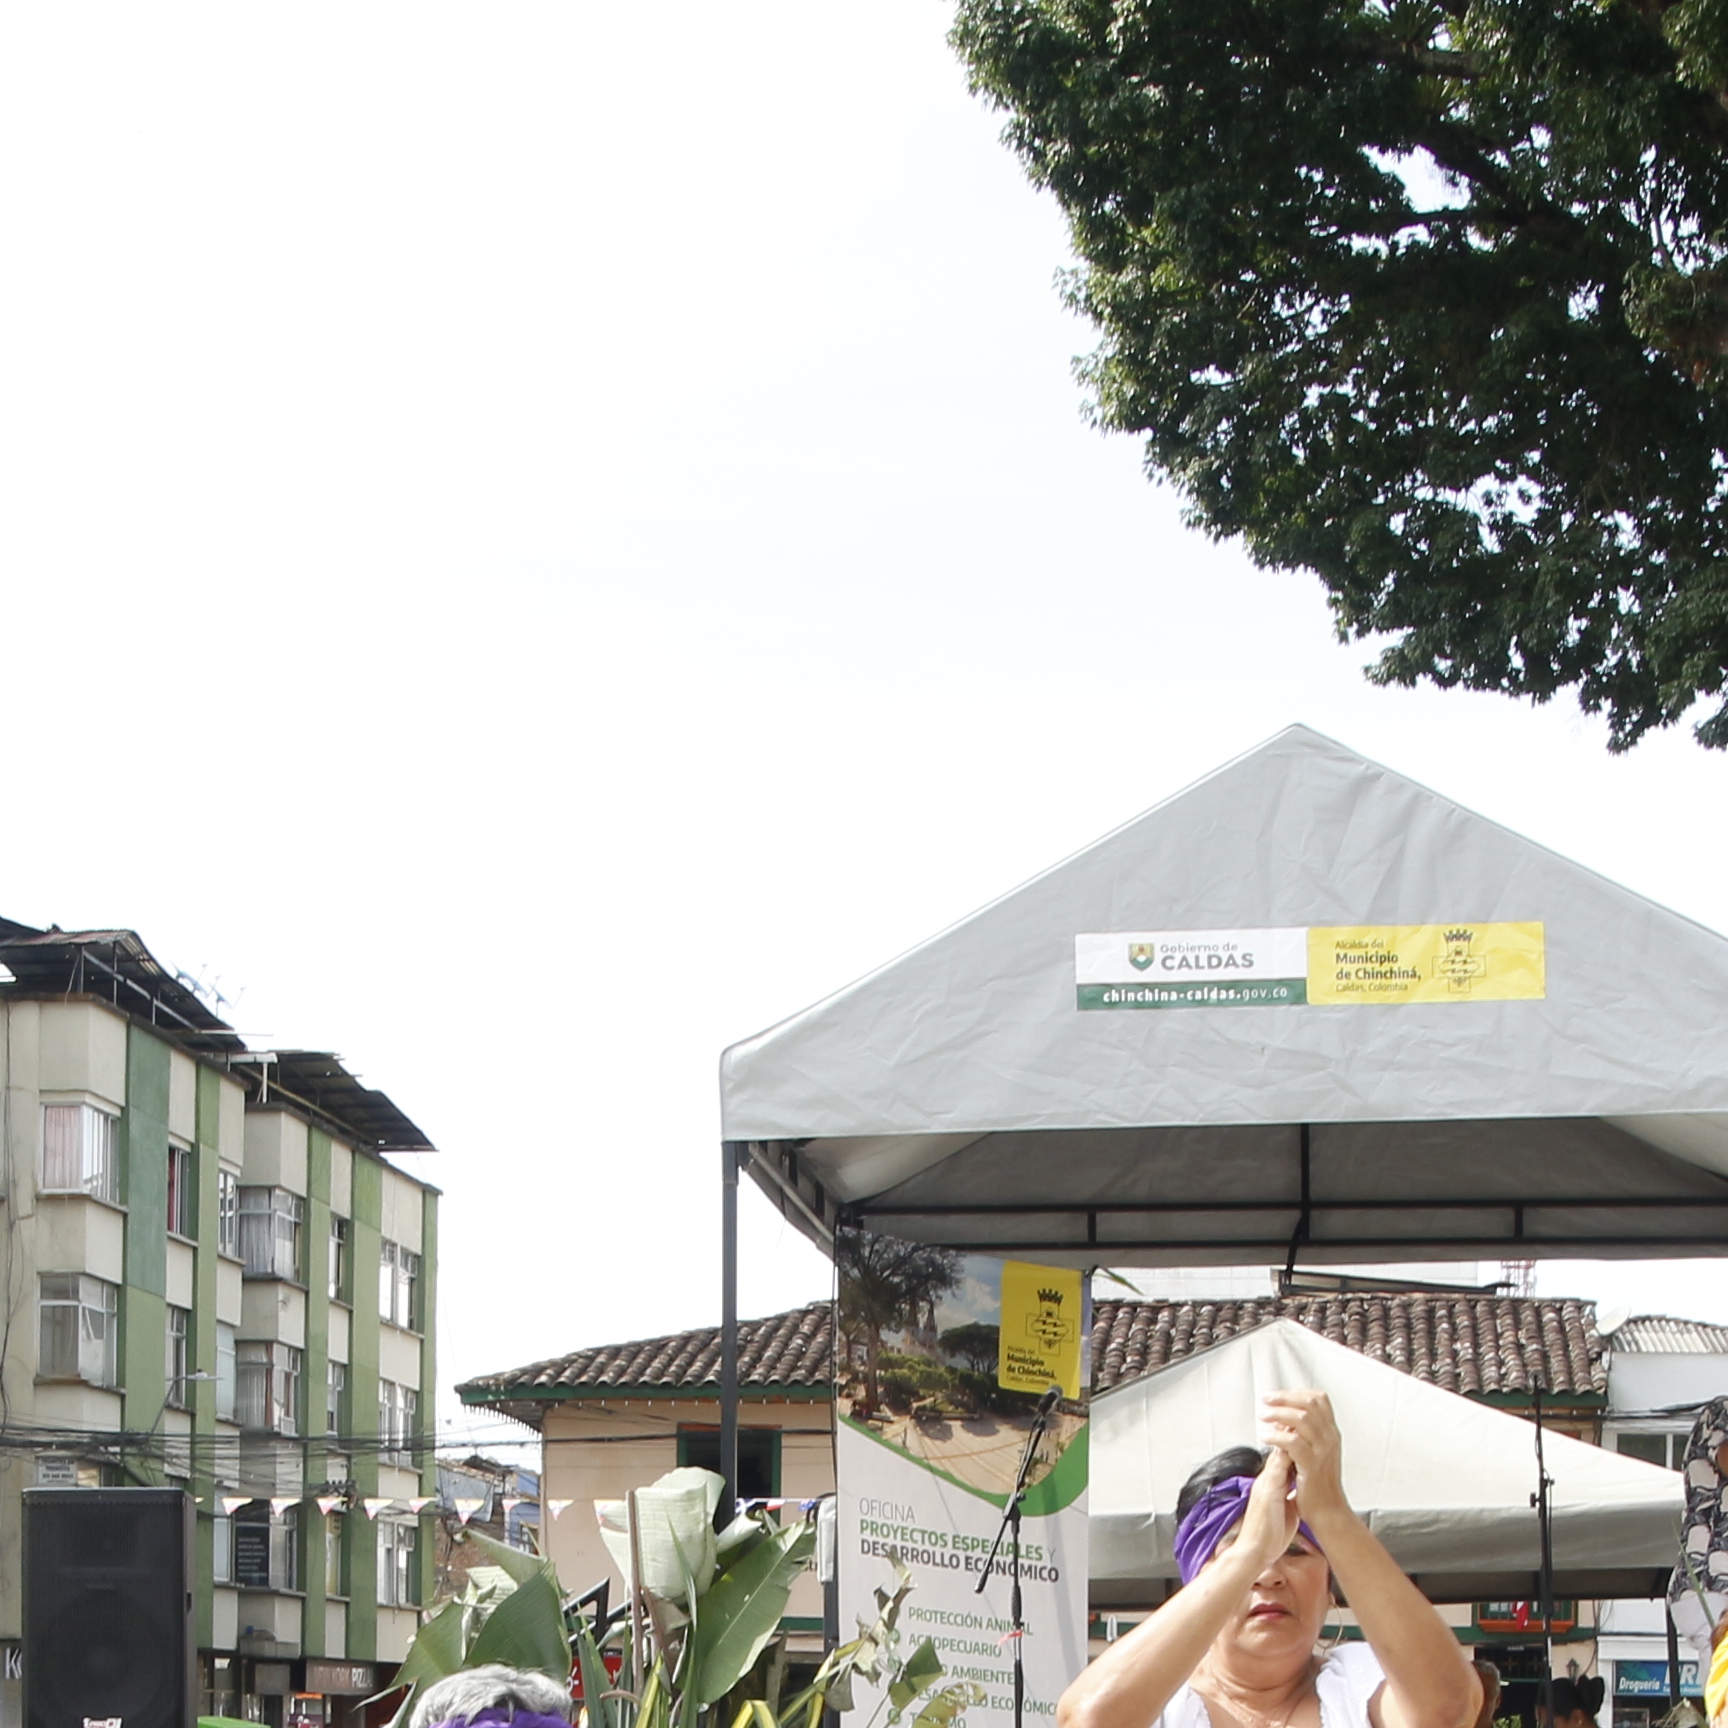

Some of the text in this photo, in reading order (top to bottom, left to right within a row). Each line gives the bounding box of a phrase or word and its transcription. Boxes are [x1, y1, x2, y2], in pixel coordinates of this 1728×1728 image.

[1160, 942, 1239, 954] Gobierno de
[1160, 953, 1255, 971] CALDAS
[1335, 951, 1399, 966] Municipio
[1336, 966, 1422, 982] de Chinchiná,
[1369, 981, 1408, 992] Colombia
[859, 1498, 916, 1524] OFICINA
[860, 1518, 1056, 1564] PROYECTOS ESPECIALES Y
[908, 1606, 984, 1632] PROTECCIÓN
[951, 1664, 1015, 1686] AMBIENTE
[1619, 1677, 1661, 1692] Droguería
